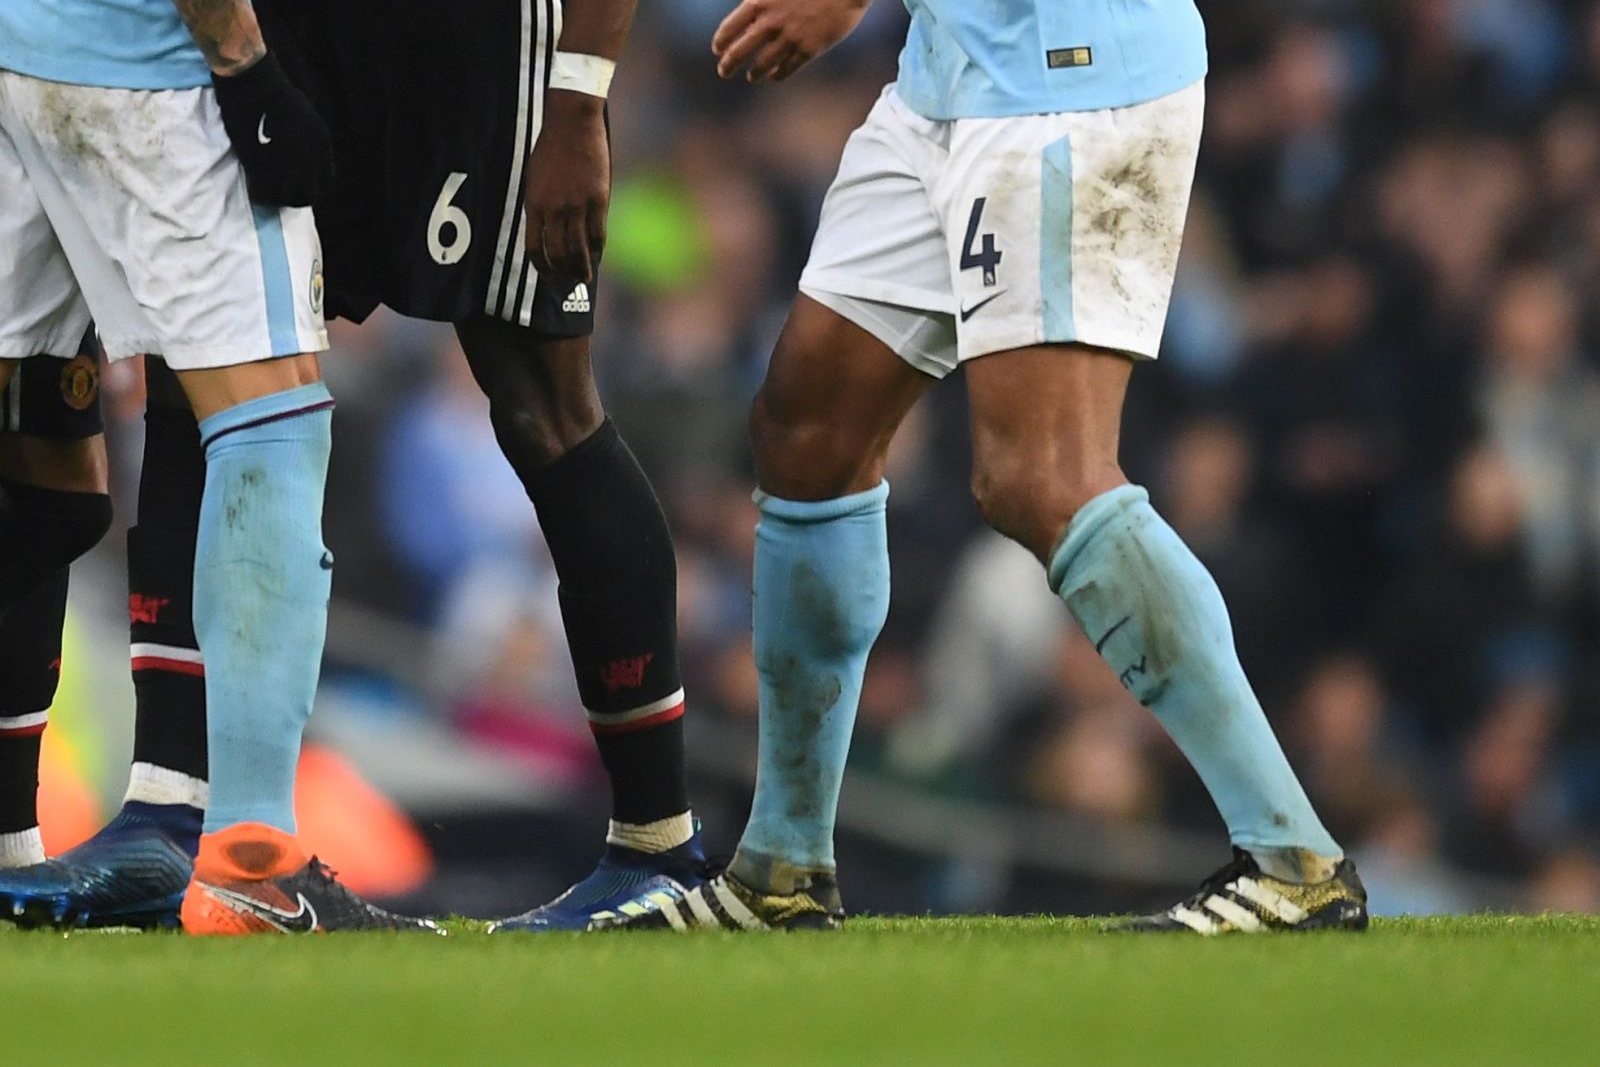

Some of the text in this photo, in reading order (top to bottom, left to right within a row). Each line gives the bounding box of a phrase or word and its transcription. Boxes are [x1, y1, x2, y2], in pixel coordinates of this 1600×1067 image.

[427, 172, 471, 265] 6
[959, 196, 1002, 286] 4
[562, 299, 590, 313] adida
